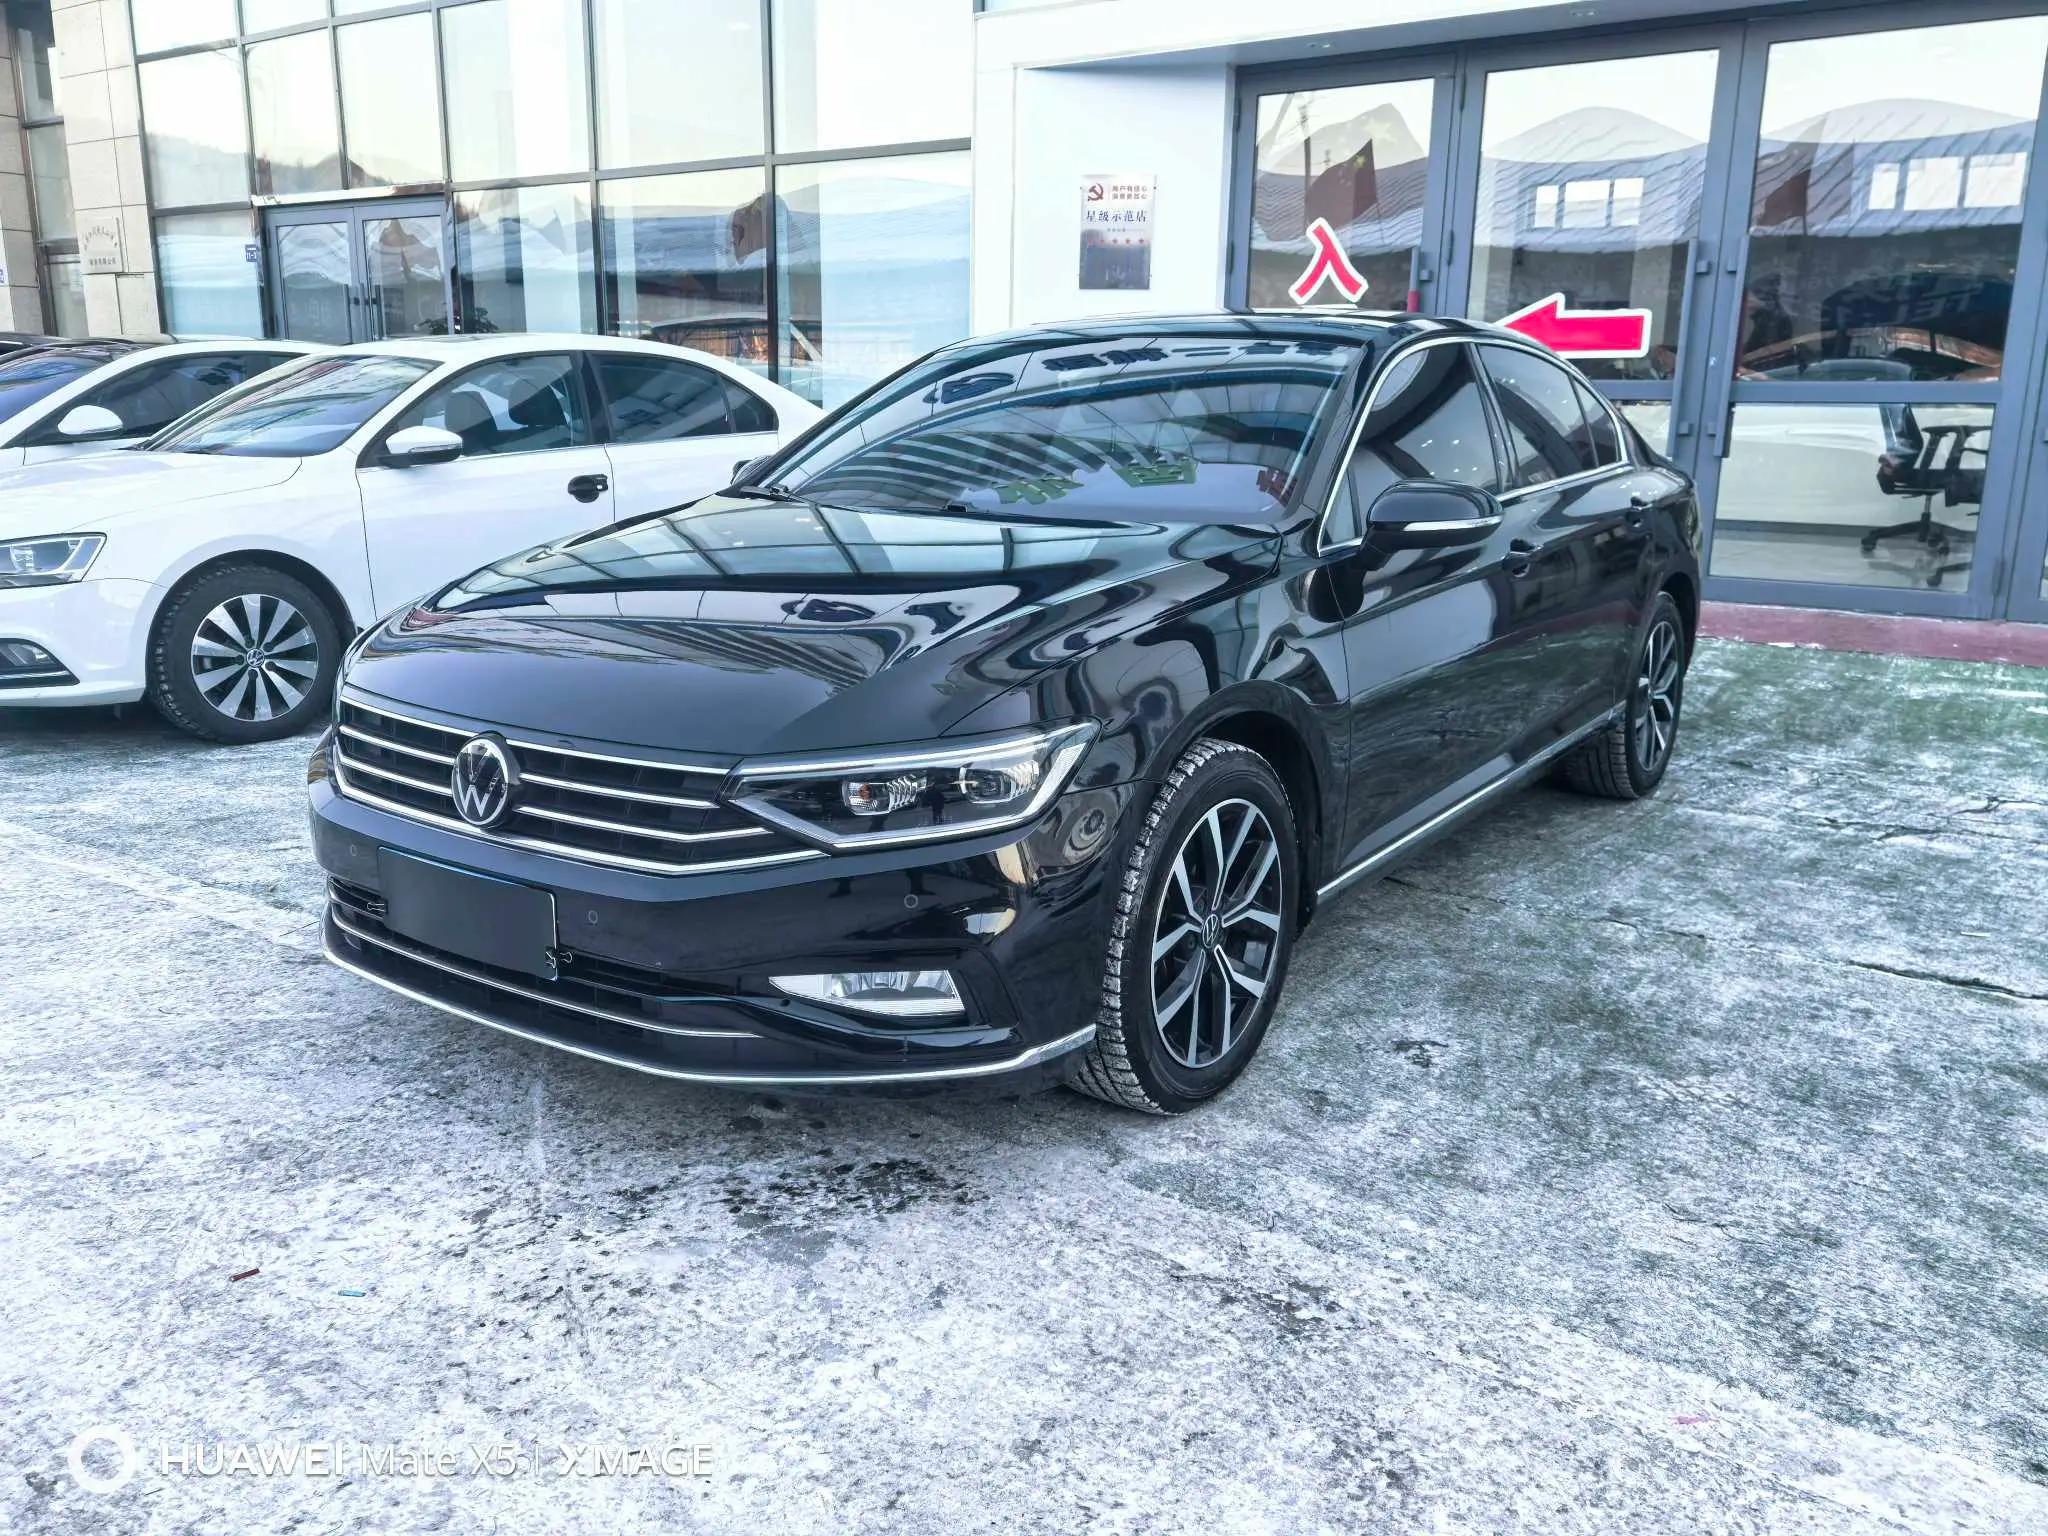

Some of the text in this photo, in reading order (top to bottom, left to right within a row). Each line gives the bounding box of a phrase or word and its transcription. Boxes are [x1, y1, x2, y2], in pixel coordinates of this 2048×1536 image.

[1086, 209, 1147, 222] 星级示范店
[1291, 220, 1366, 302] 入
